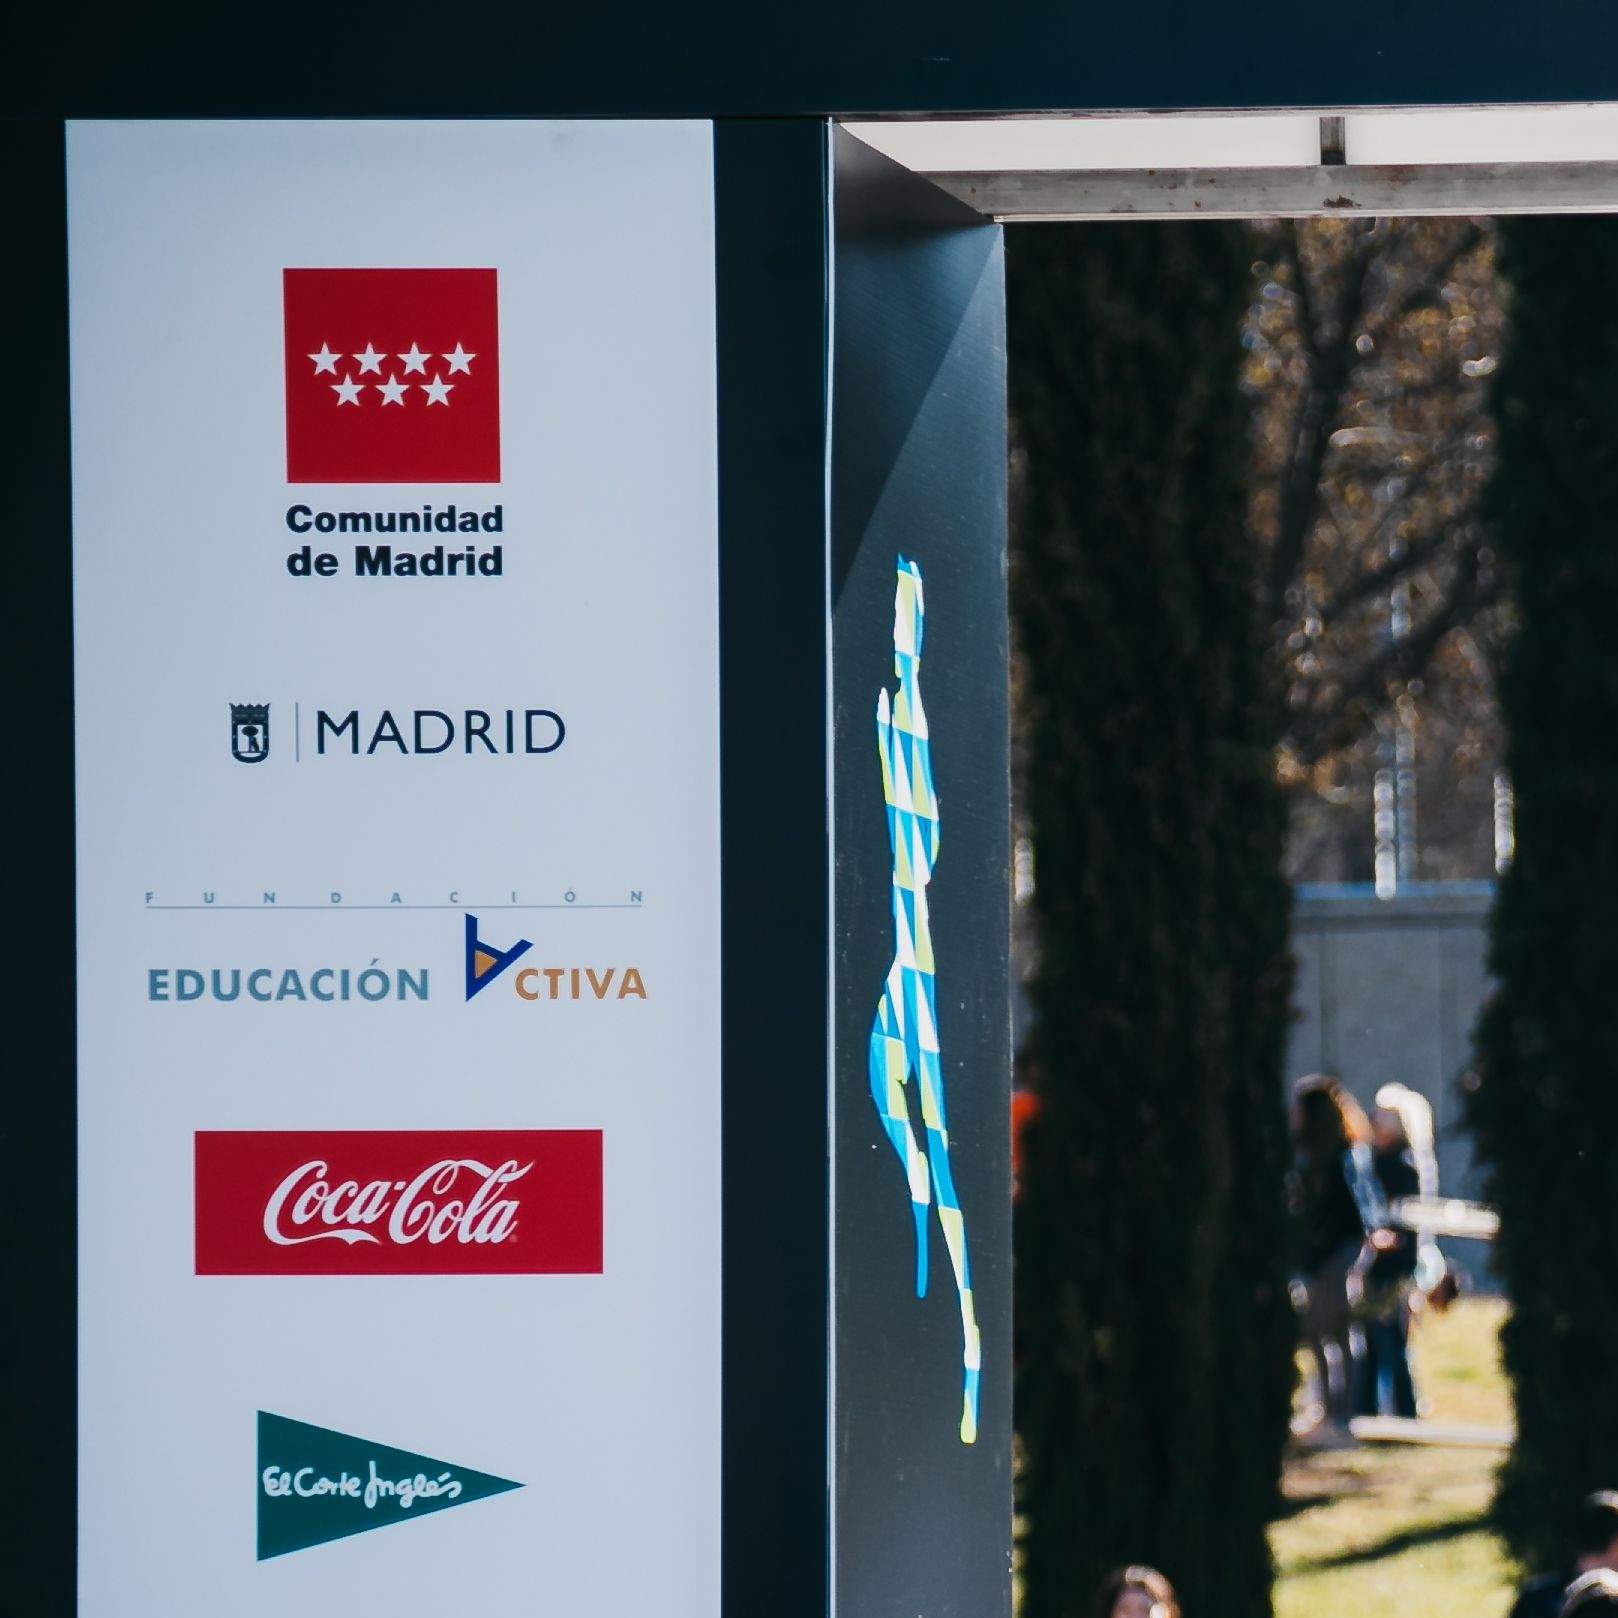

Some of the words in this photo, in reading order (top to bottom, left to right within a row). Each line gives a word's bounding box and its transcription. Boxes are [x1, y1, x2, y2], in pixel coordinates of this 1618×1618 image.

[286, 504, 503, 533] Comunidad
[286, 545, 339, 577] de
[355, 545, 503, 577] Madrid
[316, 709, 566, 755] MADRID
[145, 887, 642, 904] FUNDACIÓN
[148, 958, 430, 1002] EDUCACIÓN
[263, 1159, 536, 1247] Coca-Cola
[262, 1466, 292, 1497] El
[294, 1467, 361, 1497] Corte
[364, 1460, 462, 1508] Inglés
